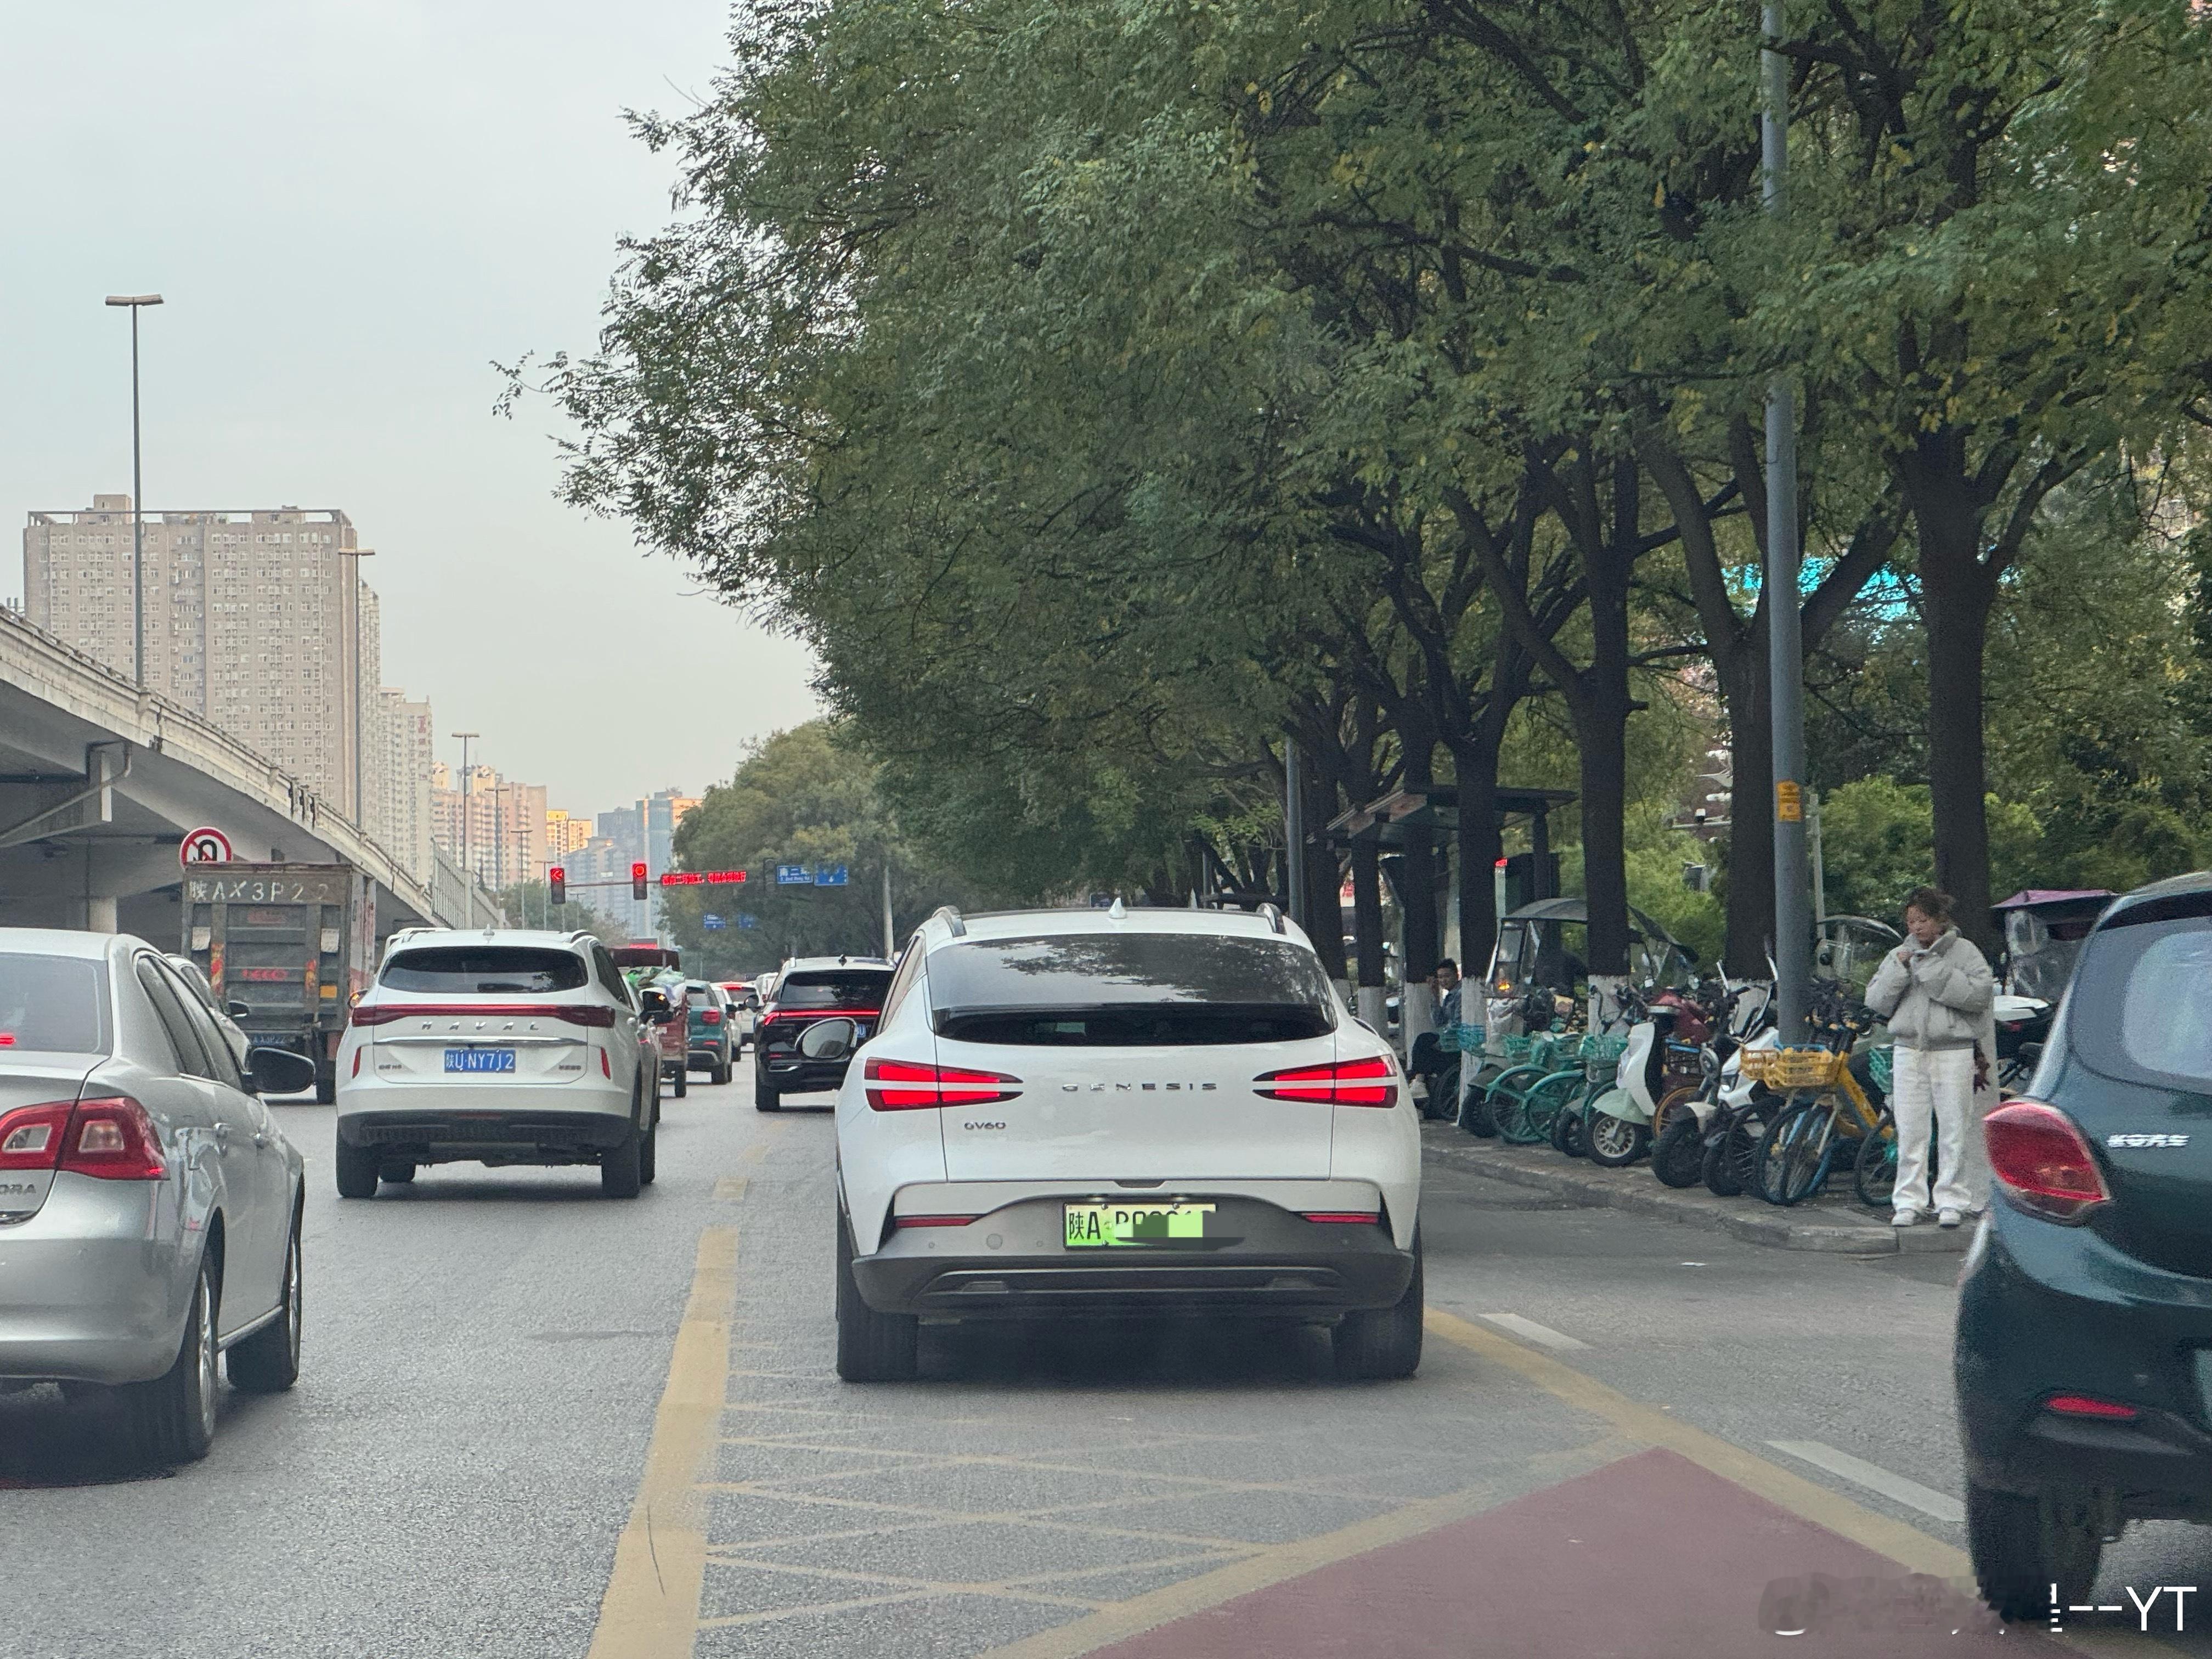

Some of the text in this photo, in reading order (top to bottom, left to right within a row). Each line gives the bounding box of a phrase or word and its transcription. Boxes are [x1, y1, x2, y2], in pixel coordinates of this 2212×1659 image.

[421, 1021, 539, 1031] HAVAL
[1062, 1082, 1217, 1092] GENESIS
[964, 1121, 1007, 1131] GV60
